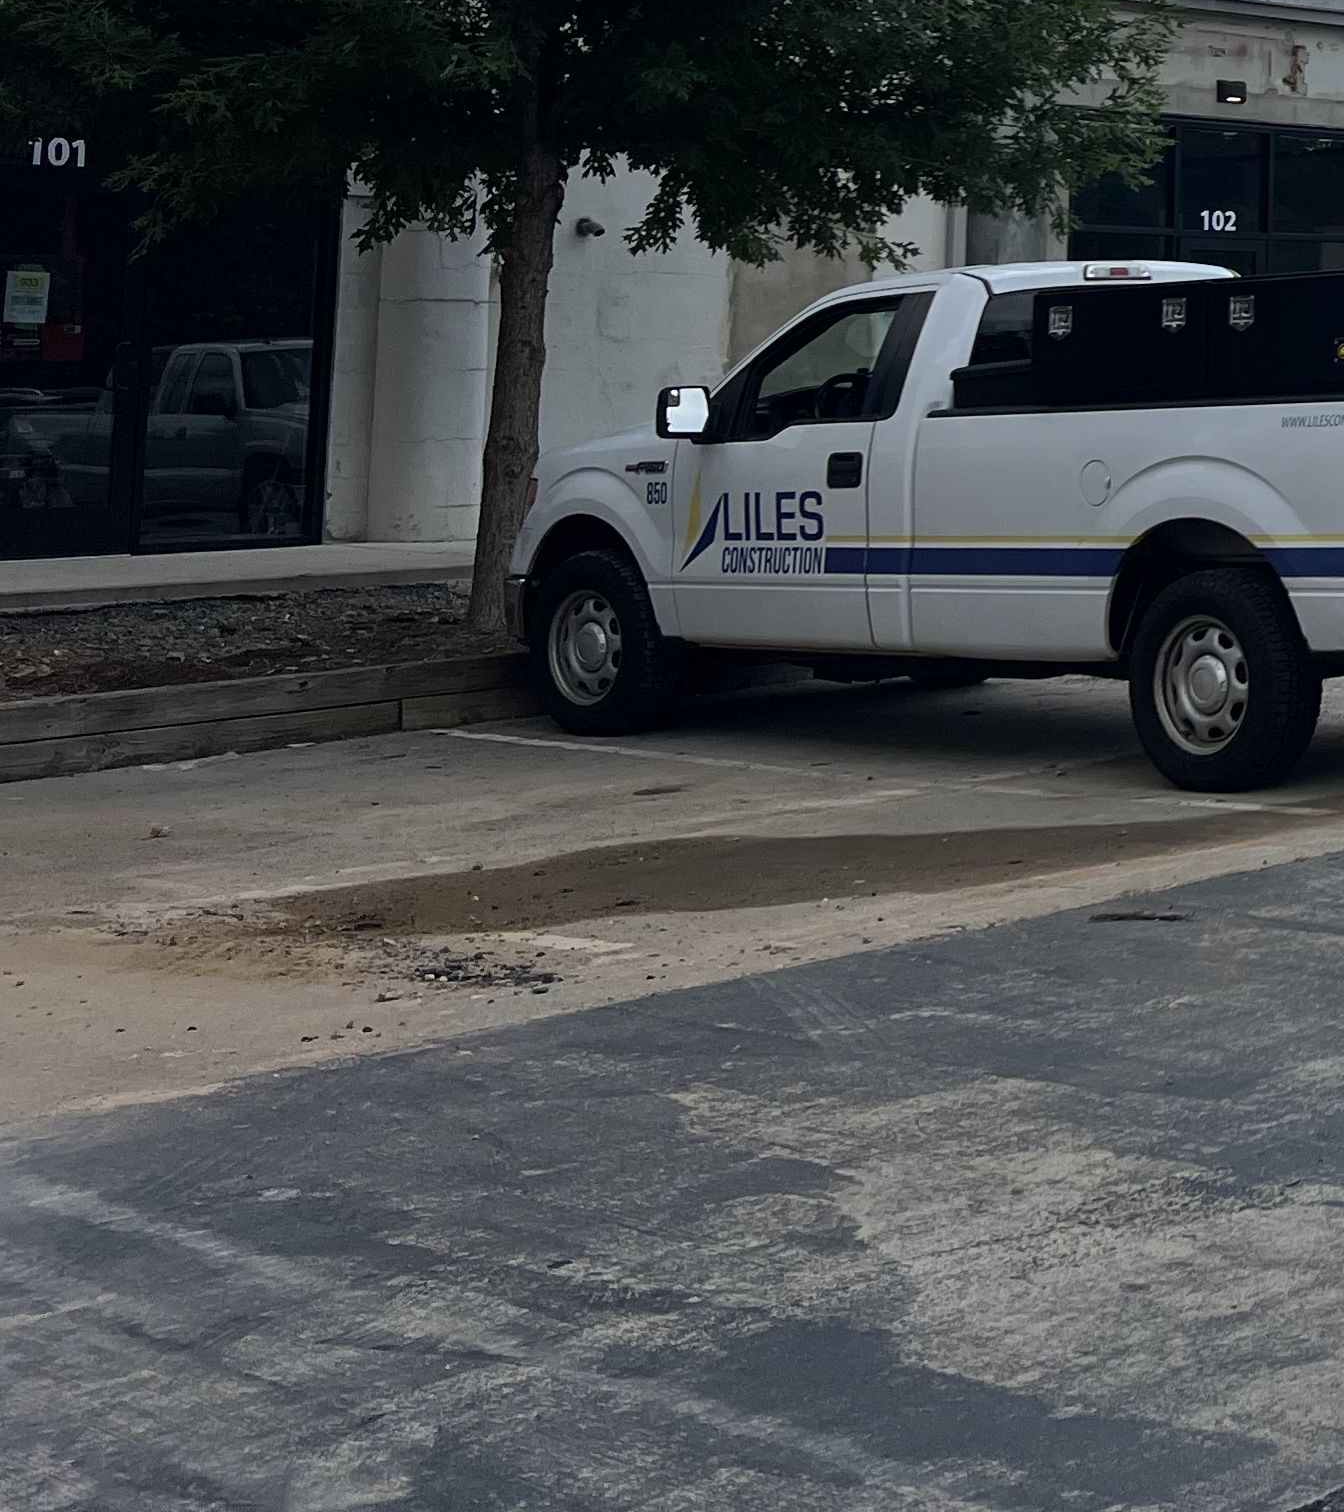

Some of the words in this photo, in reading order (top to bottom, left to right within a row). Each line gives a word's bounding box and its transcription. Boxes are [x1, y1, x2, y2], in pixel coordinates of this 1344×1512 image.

[29, 137, 86, 168] 101
[1200, 210, 1237, 231] 102
[646, 481, 668, 505] 850
[723, 491, 824, 541] LILES
[721, 546, 823, 574] CONSTRUCTION
